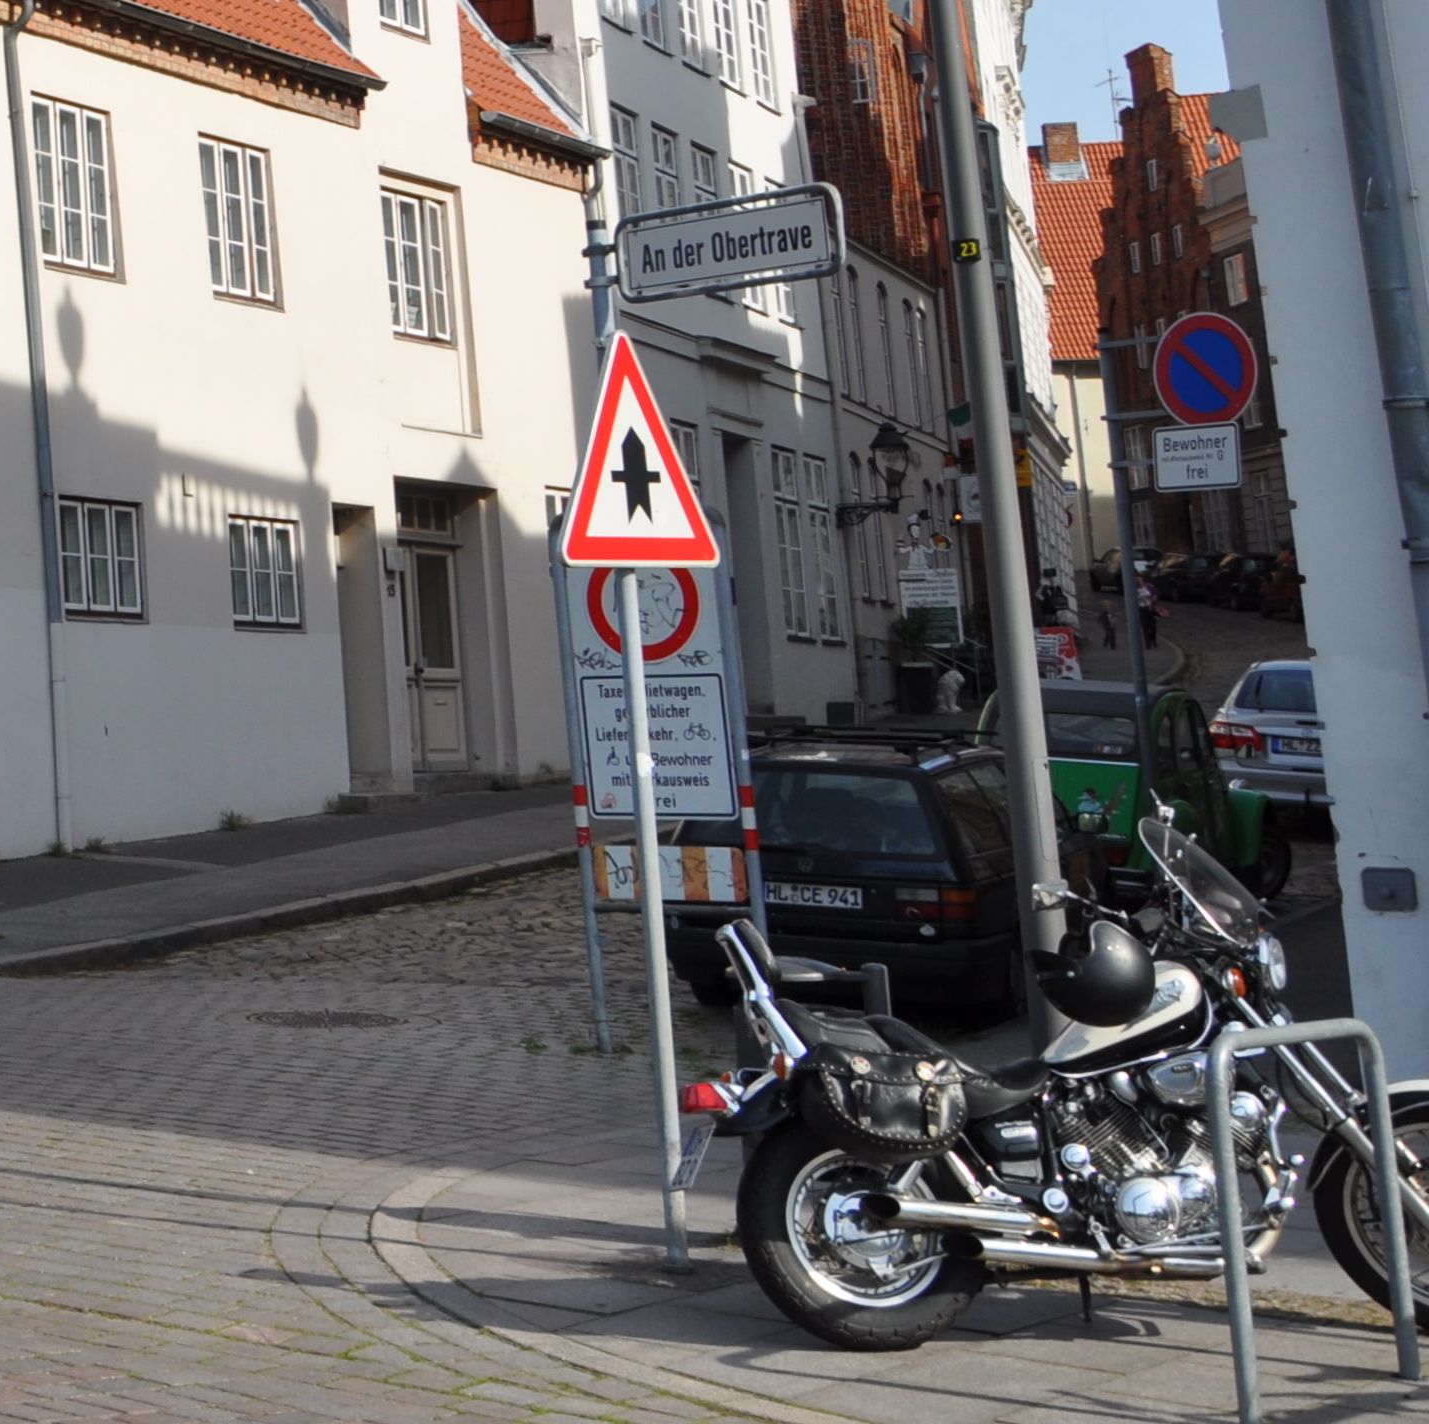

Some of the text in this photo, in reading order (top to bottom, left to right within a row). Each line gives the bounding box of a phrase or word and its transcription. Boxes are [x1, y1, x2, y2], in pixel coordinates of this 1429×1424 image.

[642, 225, 813, 274] An der Obertrave
[960, 242, 977, 257] 23
[1162, 435, 1227, 452] Bewohner
[1186, 464, 1208, 480] frei
[597, 684, 624, 699] Taxe
[651, 752, 713, 766] Bewohner
[611, 772, 710, 787] mit kausweis
[656, 793, 676, 808] rei
[766, 883, 860, 907] HL CE 941
